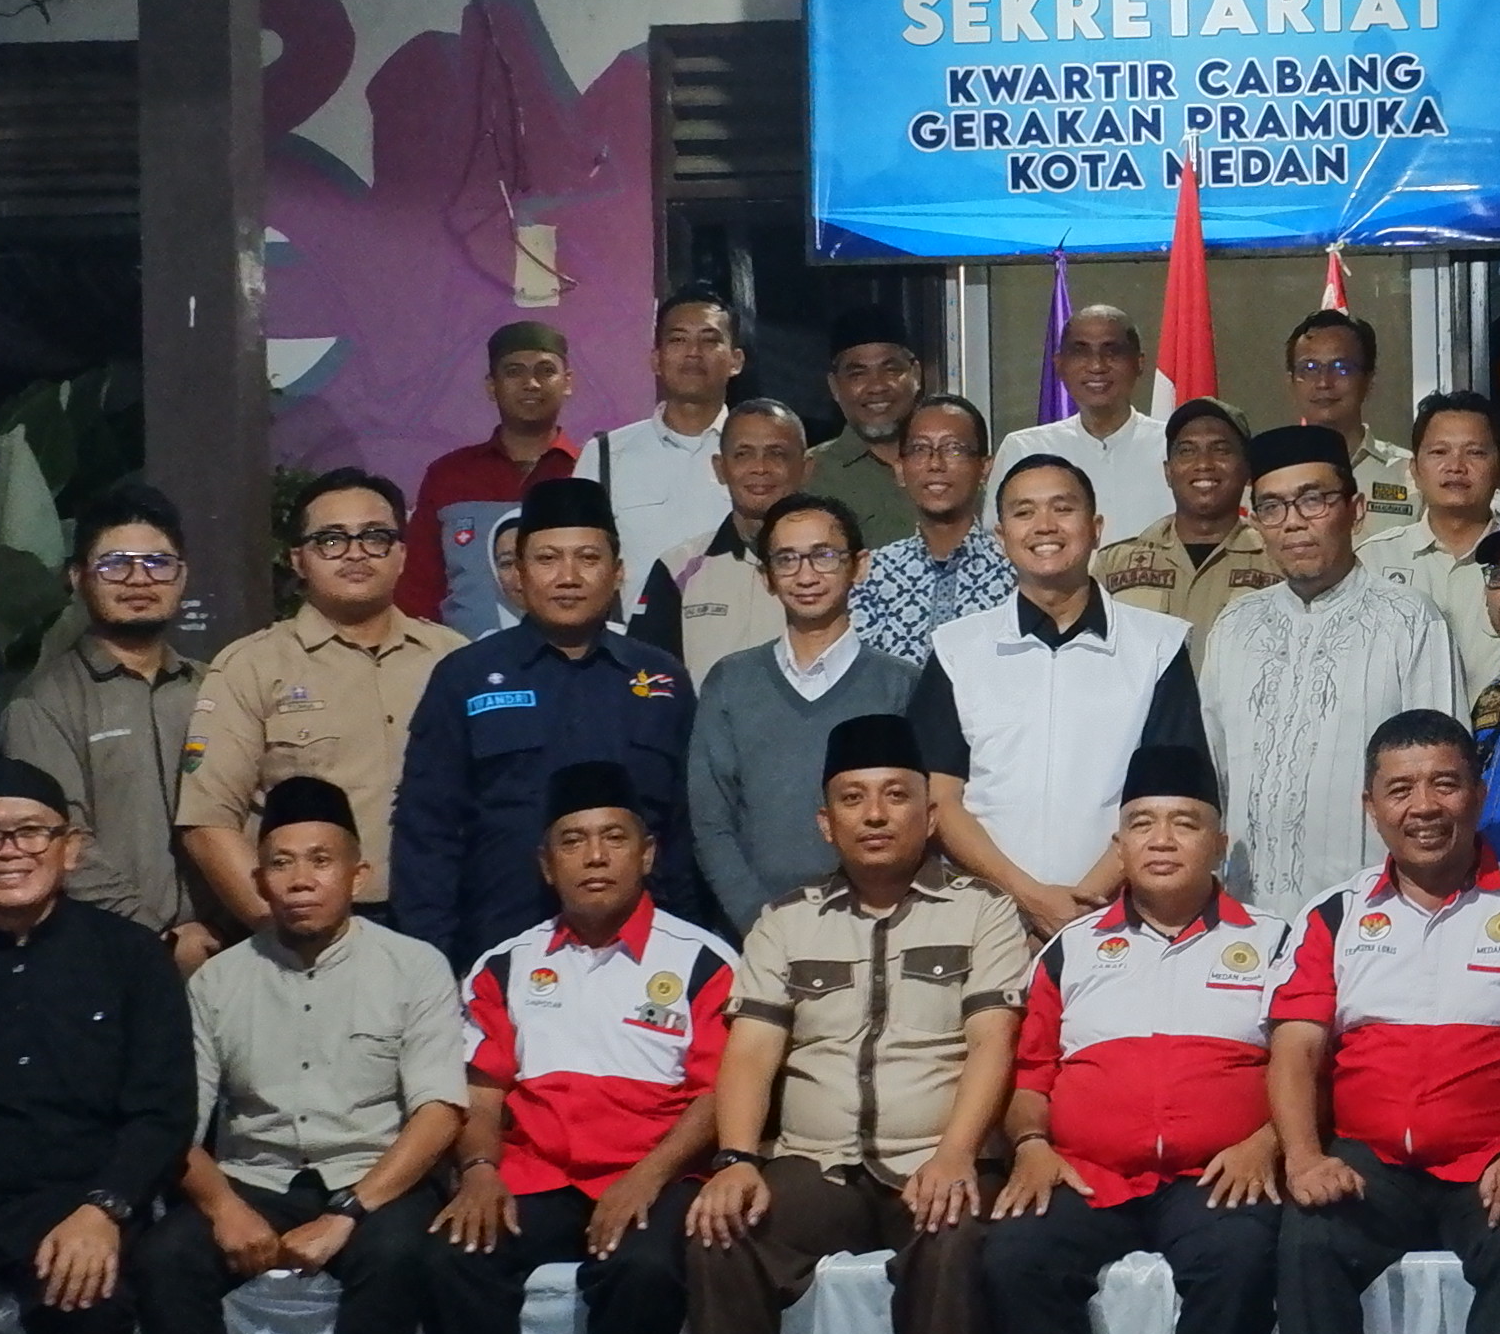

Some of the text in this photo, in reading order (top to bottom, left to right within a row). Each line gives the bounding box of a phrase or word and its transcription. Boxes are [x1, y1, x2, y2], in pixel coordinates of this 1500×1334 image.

[945, 53, 1424, 107] KWARTIR CABANG
[908, 95, 1449, 153] GERAKAN PRAMUKA
[1008, 151, 1145, 193] KOTA
